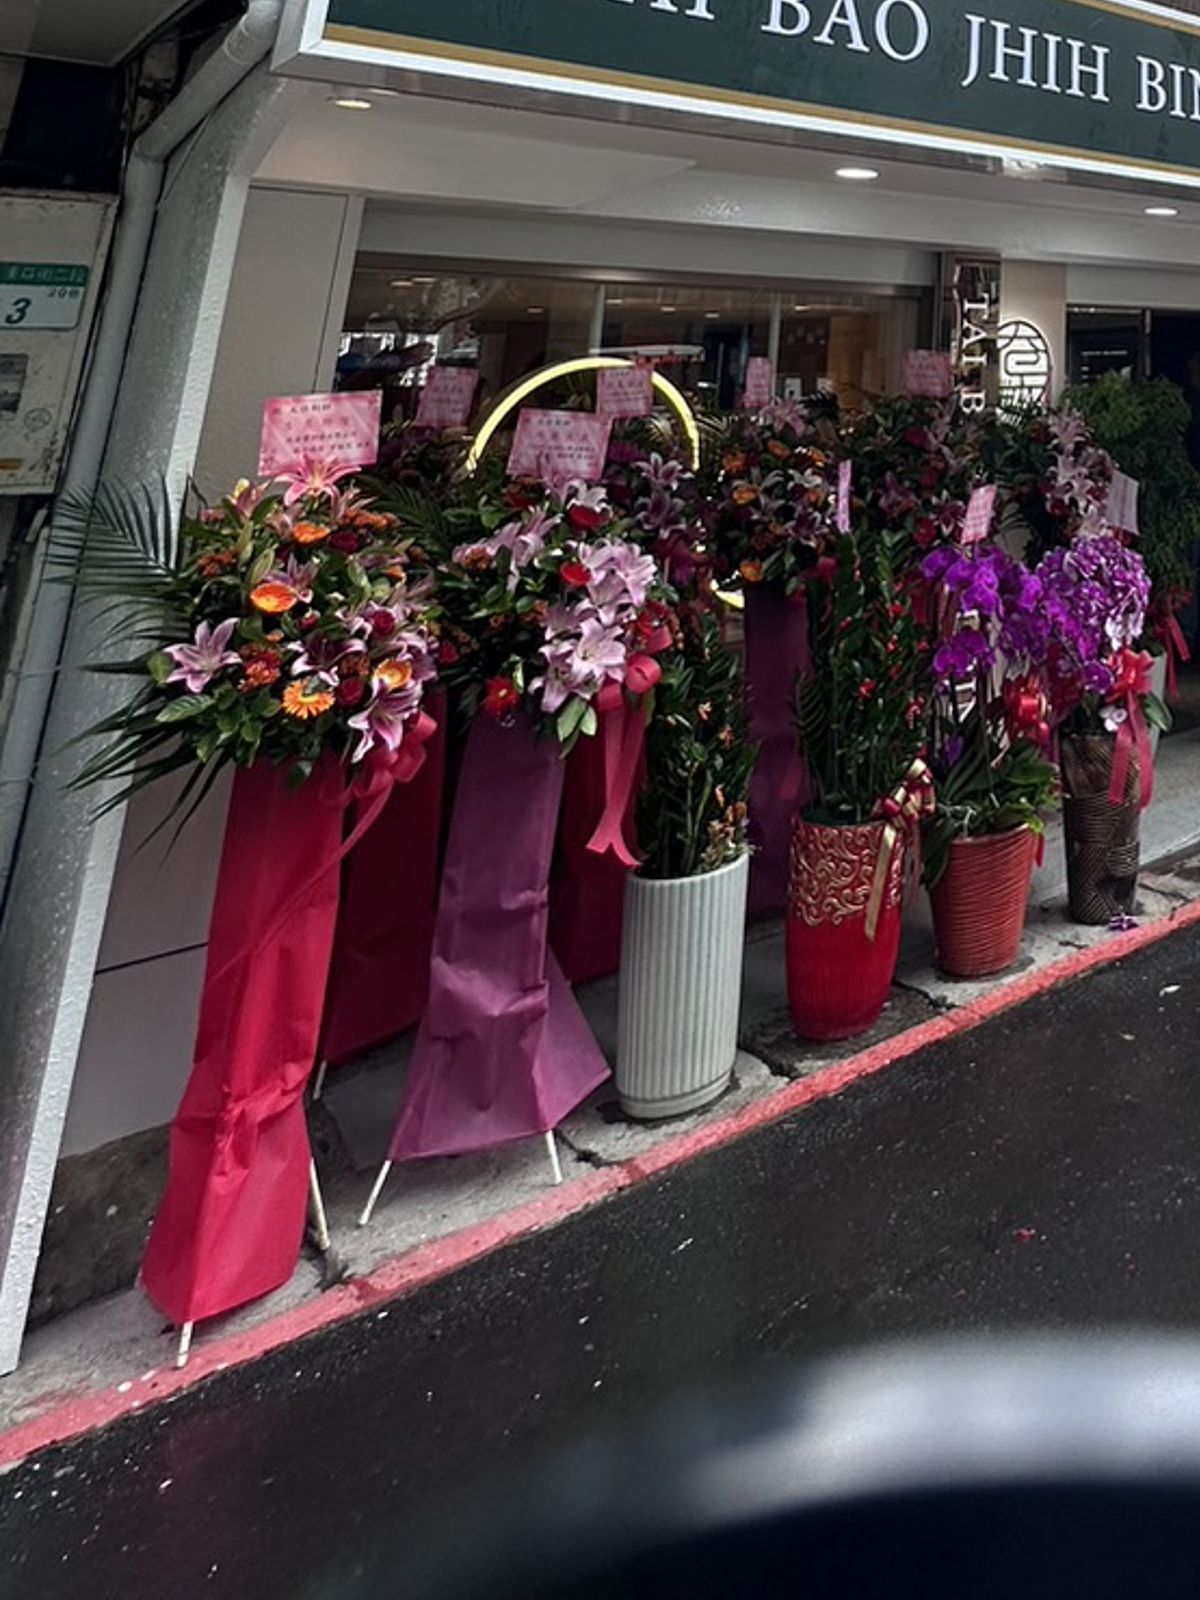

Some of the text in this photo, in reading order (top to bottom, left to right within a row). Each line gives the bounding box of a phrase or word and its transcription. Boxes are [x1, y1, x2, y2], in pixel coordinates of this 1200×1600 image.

[961, 12, 1111, 103] JHIH
[5, 296, 33, 325] 3
[960, 292, 991, 366] TAI
